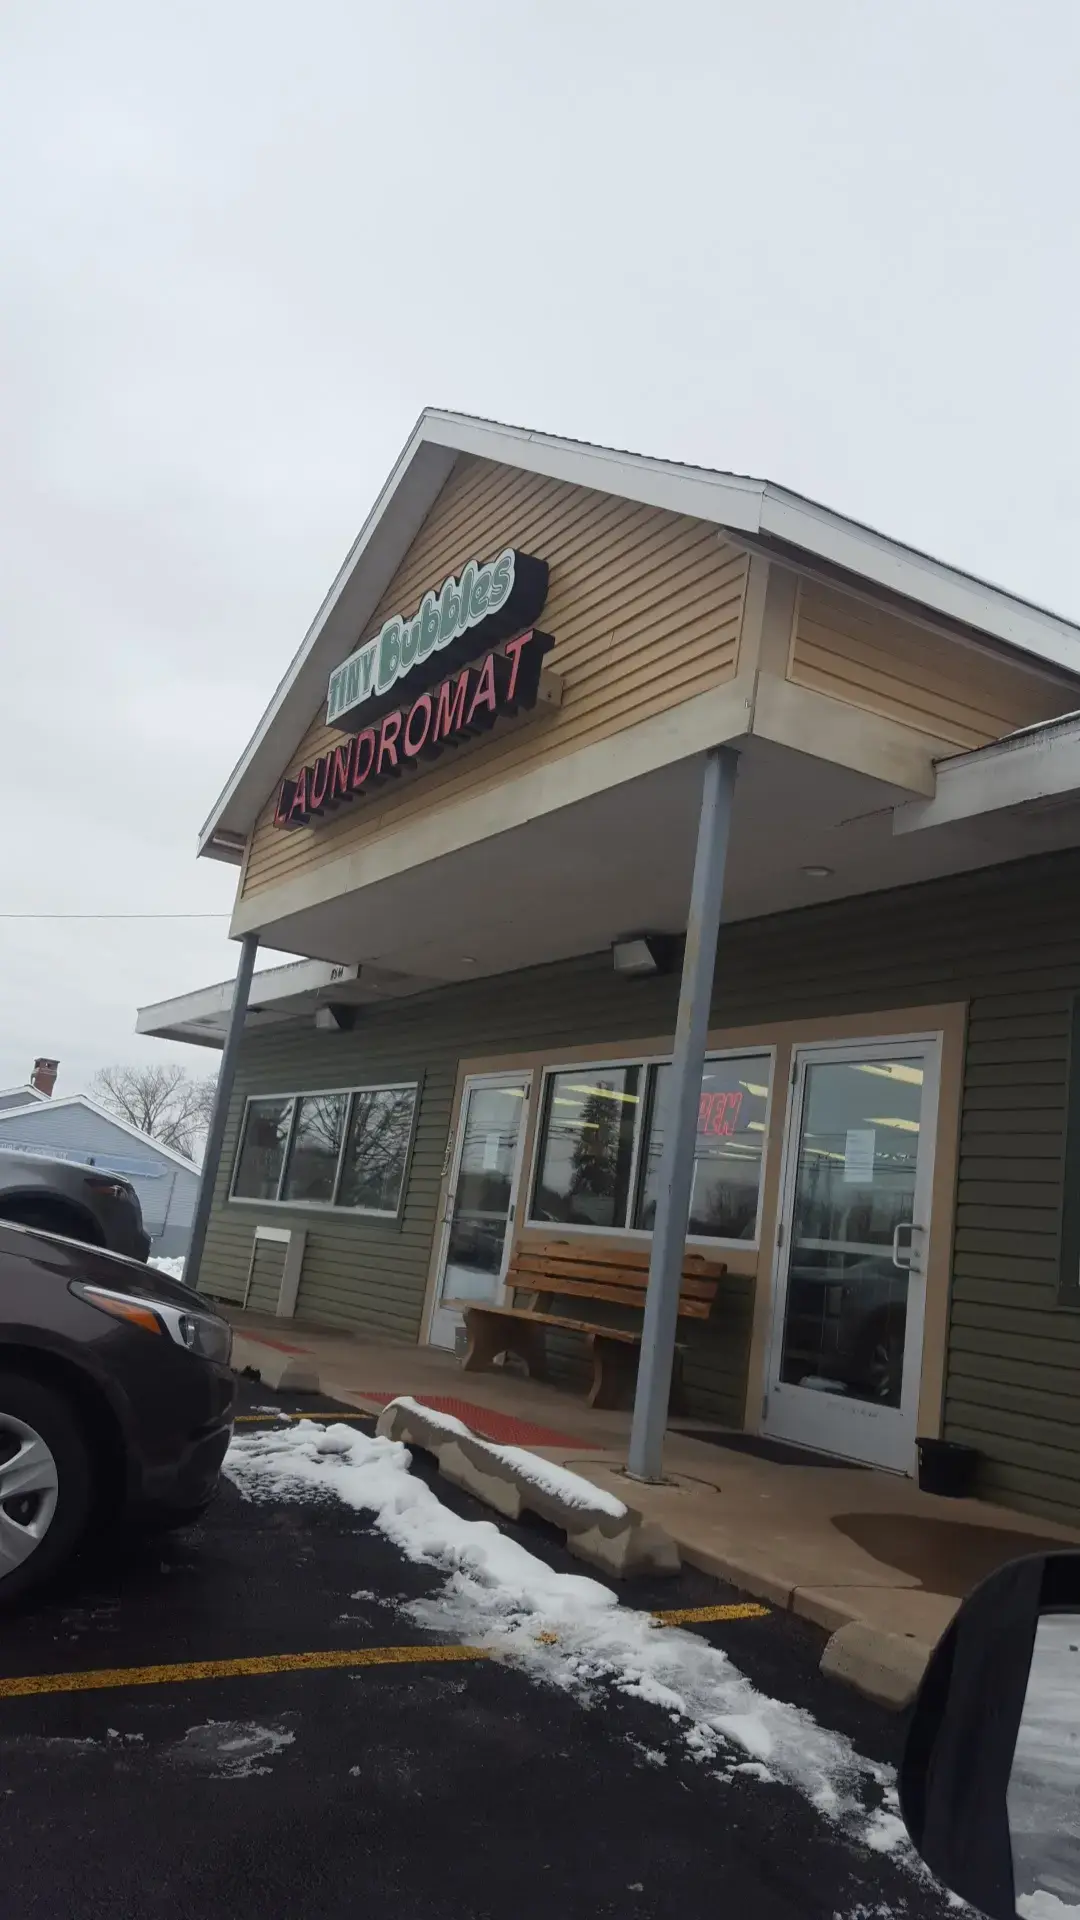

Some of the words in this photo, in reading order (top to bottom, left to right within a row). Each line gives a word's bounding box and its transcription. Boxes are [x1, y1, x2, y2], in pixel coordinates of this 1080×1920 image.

[327, 643, 378, 718] TINY
[376, 554, 513, 690] Bubbles
[273, 630, 534, 826] LAUNDROMAT
[697, 1092, 743, 1136] PEN
